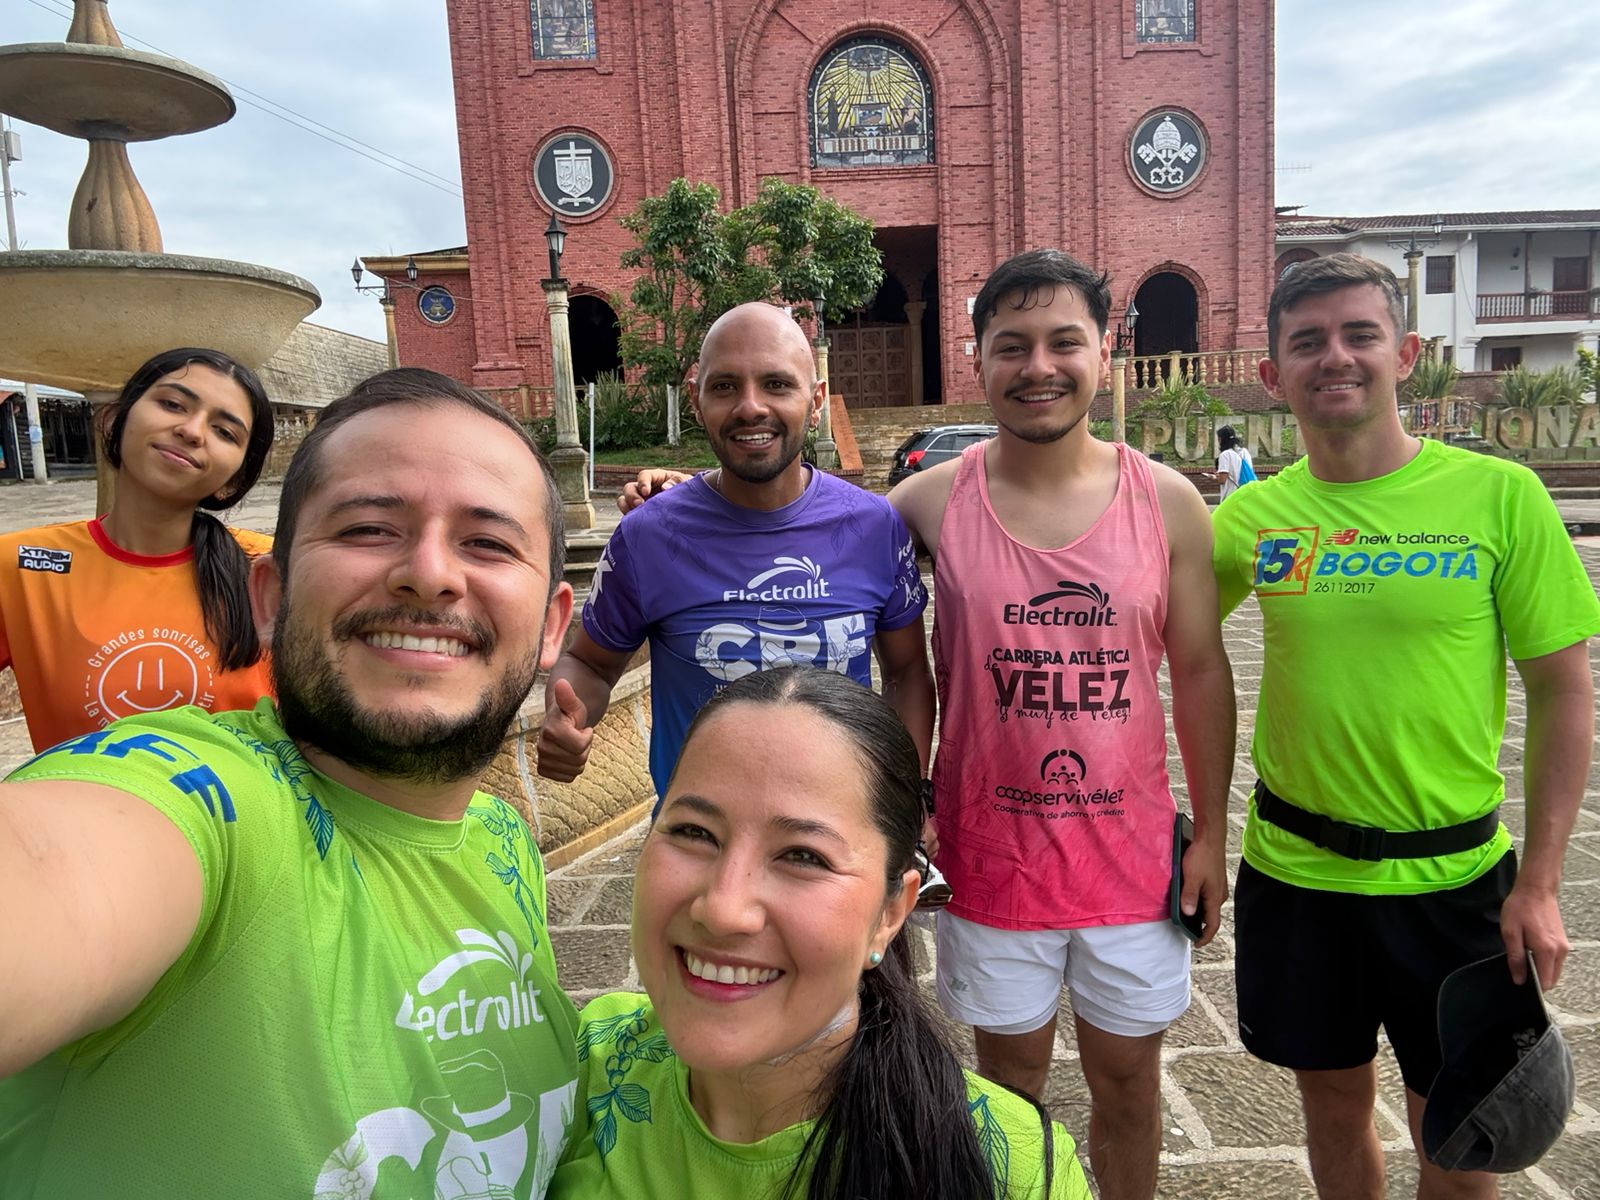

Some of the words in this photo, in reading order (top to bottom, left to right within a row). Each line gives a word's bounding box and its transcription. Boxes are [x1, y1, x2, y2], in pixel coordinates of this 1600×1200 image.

[1359, 533, 1392, 545] new
[1397, 532, 1470, 545] balance
[23, 558, 65, 572] AUDIO
[1315, 544, 1479, 580] BOGOTÁ
[723, 578, 830, 602] Electrolit
[1314, 582, 1375, 594] 26112017
[1003, 603, 1118, 627] Electrolit
[88, 628, 145, 668] Grandes
[152, 627, 211, 661] sonrisas
[992, 647, 1064, 665] CARRERA
[1068, 648, 1130, 665] ATLÉTICA
[992, 659, 1131, 712] VÉLEZ
[995, 785, 1125, 806] coopservivélez
[993, 803, 1044, 819] Cooperativa
[1046, 811, 1058, 820] de
